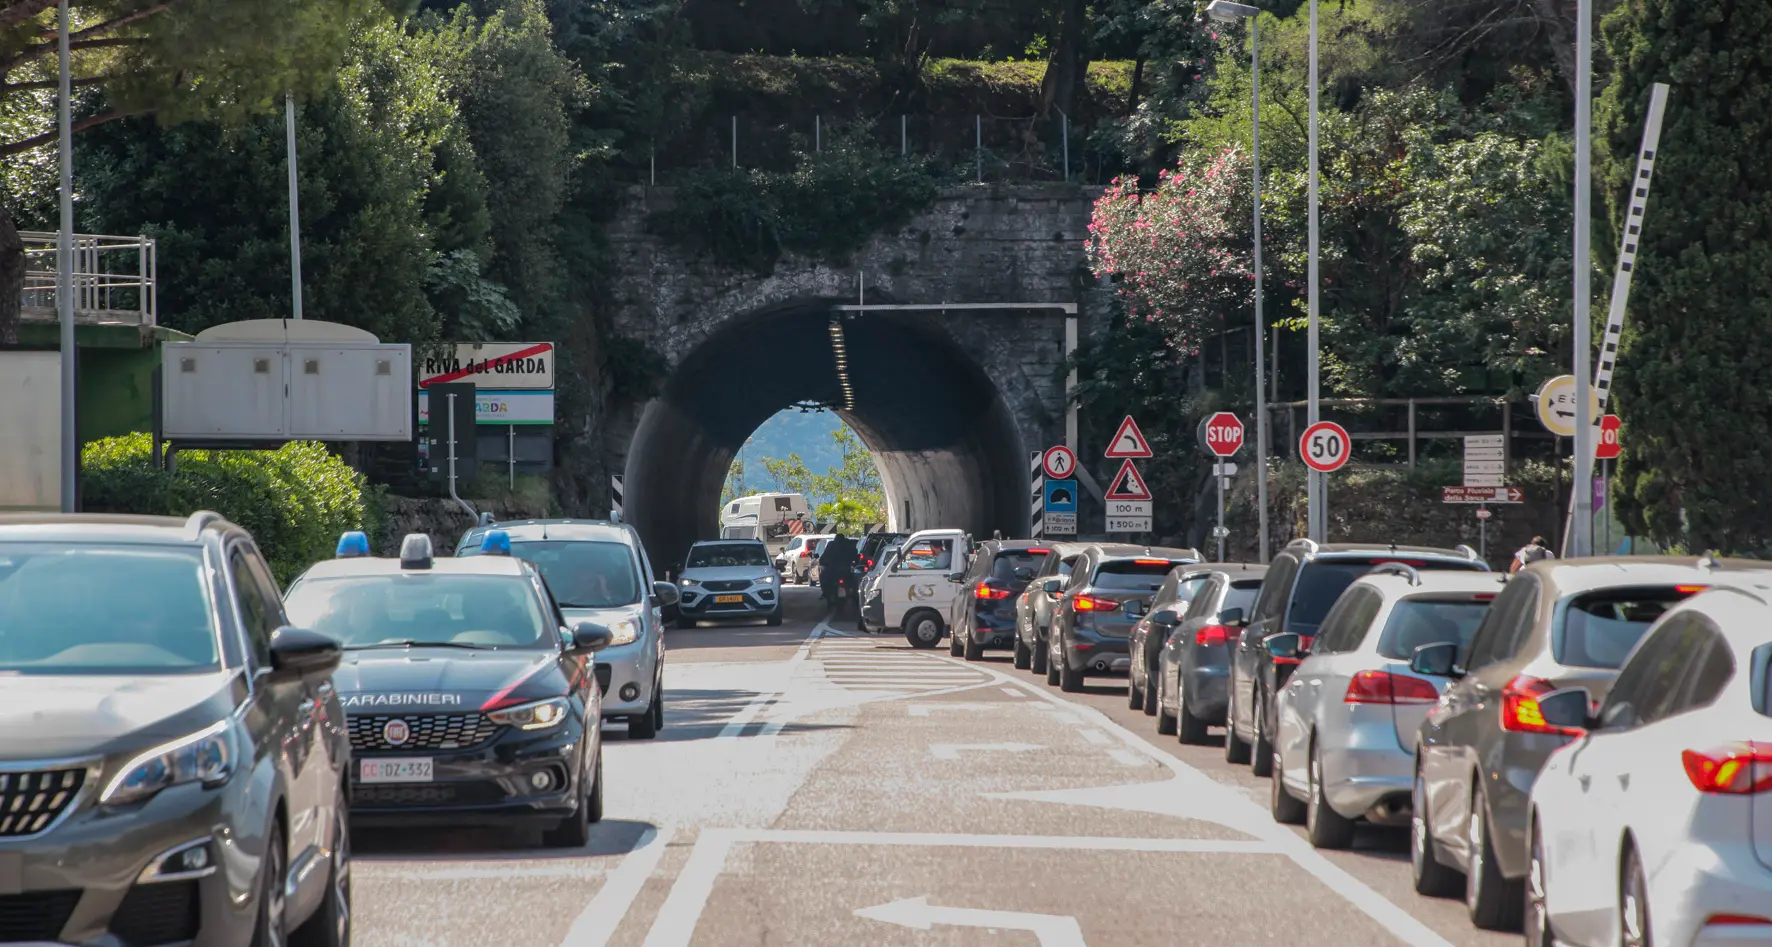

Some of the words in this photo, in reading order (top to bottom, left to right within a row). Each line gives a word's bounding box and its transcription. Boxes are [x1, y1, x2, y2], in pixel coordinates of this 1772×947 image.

[426, 358, 461, 374] RIVA
[466, 358, 489, 374] del
[495, 358, 546, 374] GARDA
[475, 402, 509, 413] ARDA
[1208, 426, 1241, 443] STOP
[1312, 435, 1340, 459] 50
[1115, 504, 1132, 512] 100
[1116, 520, 1134, 528] 500
